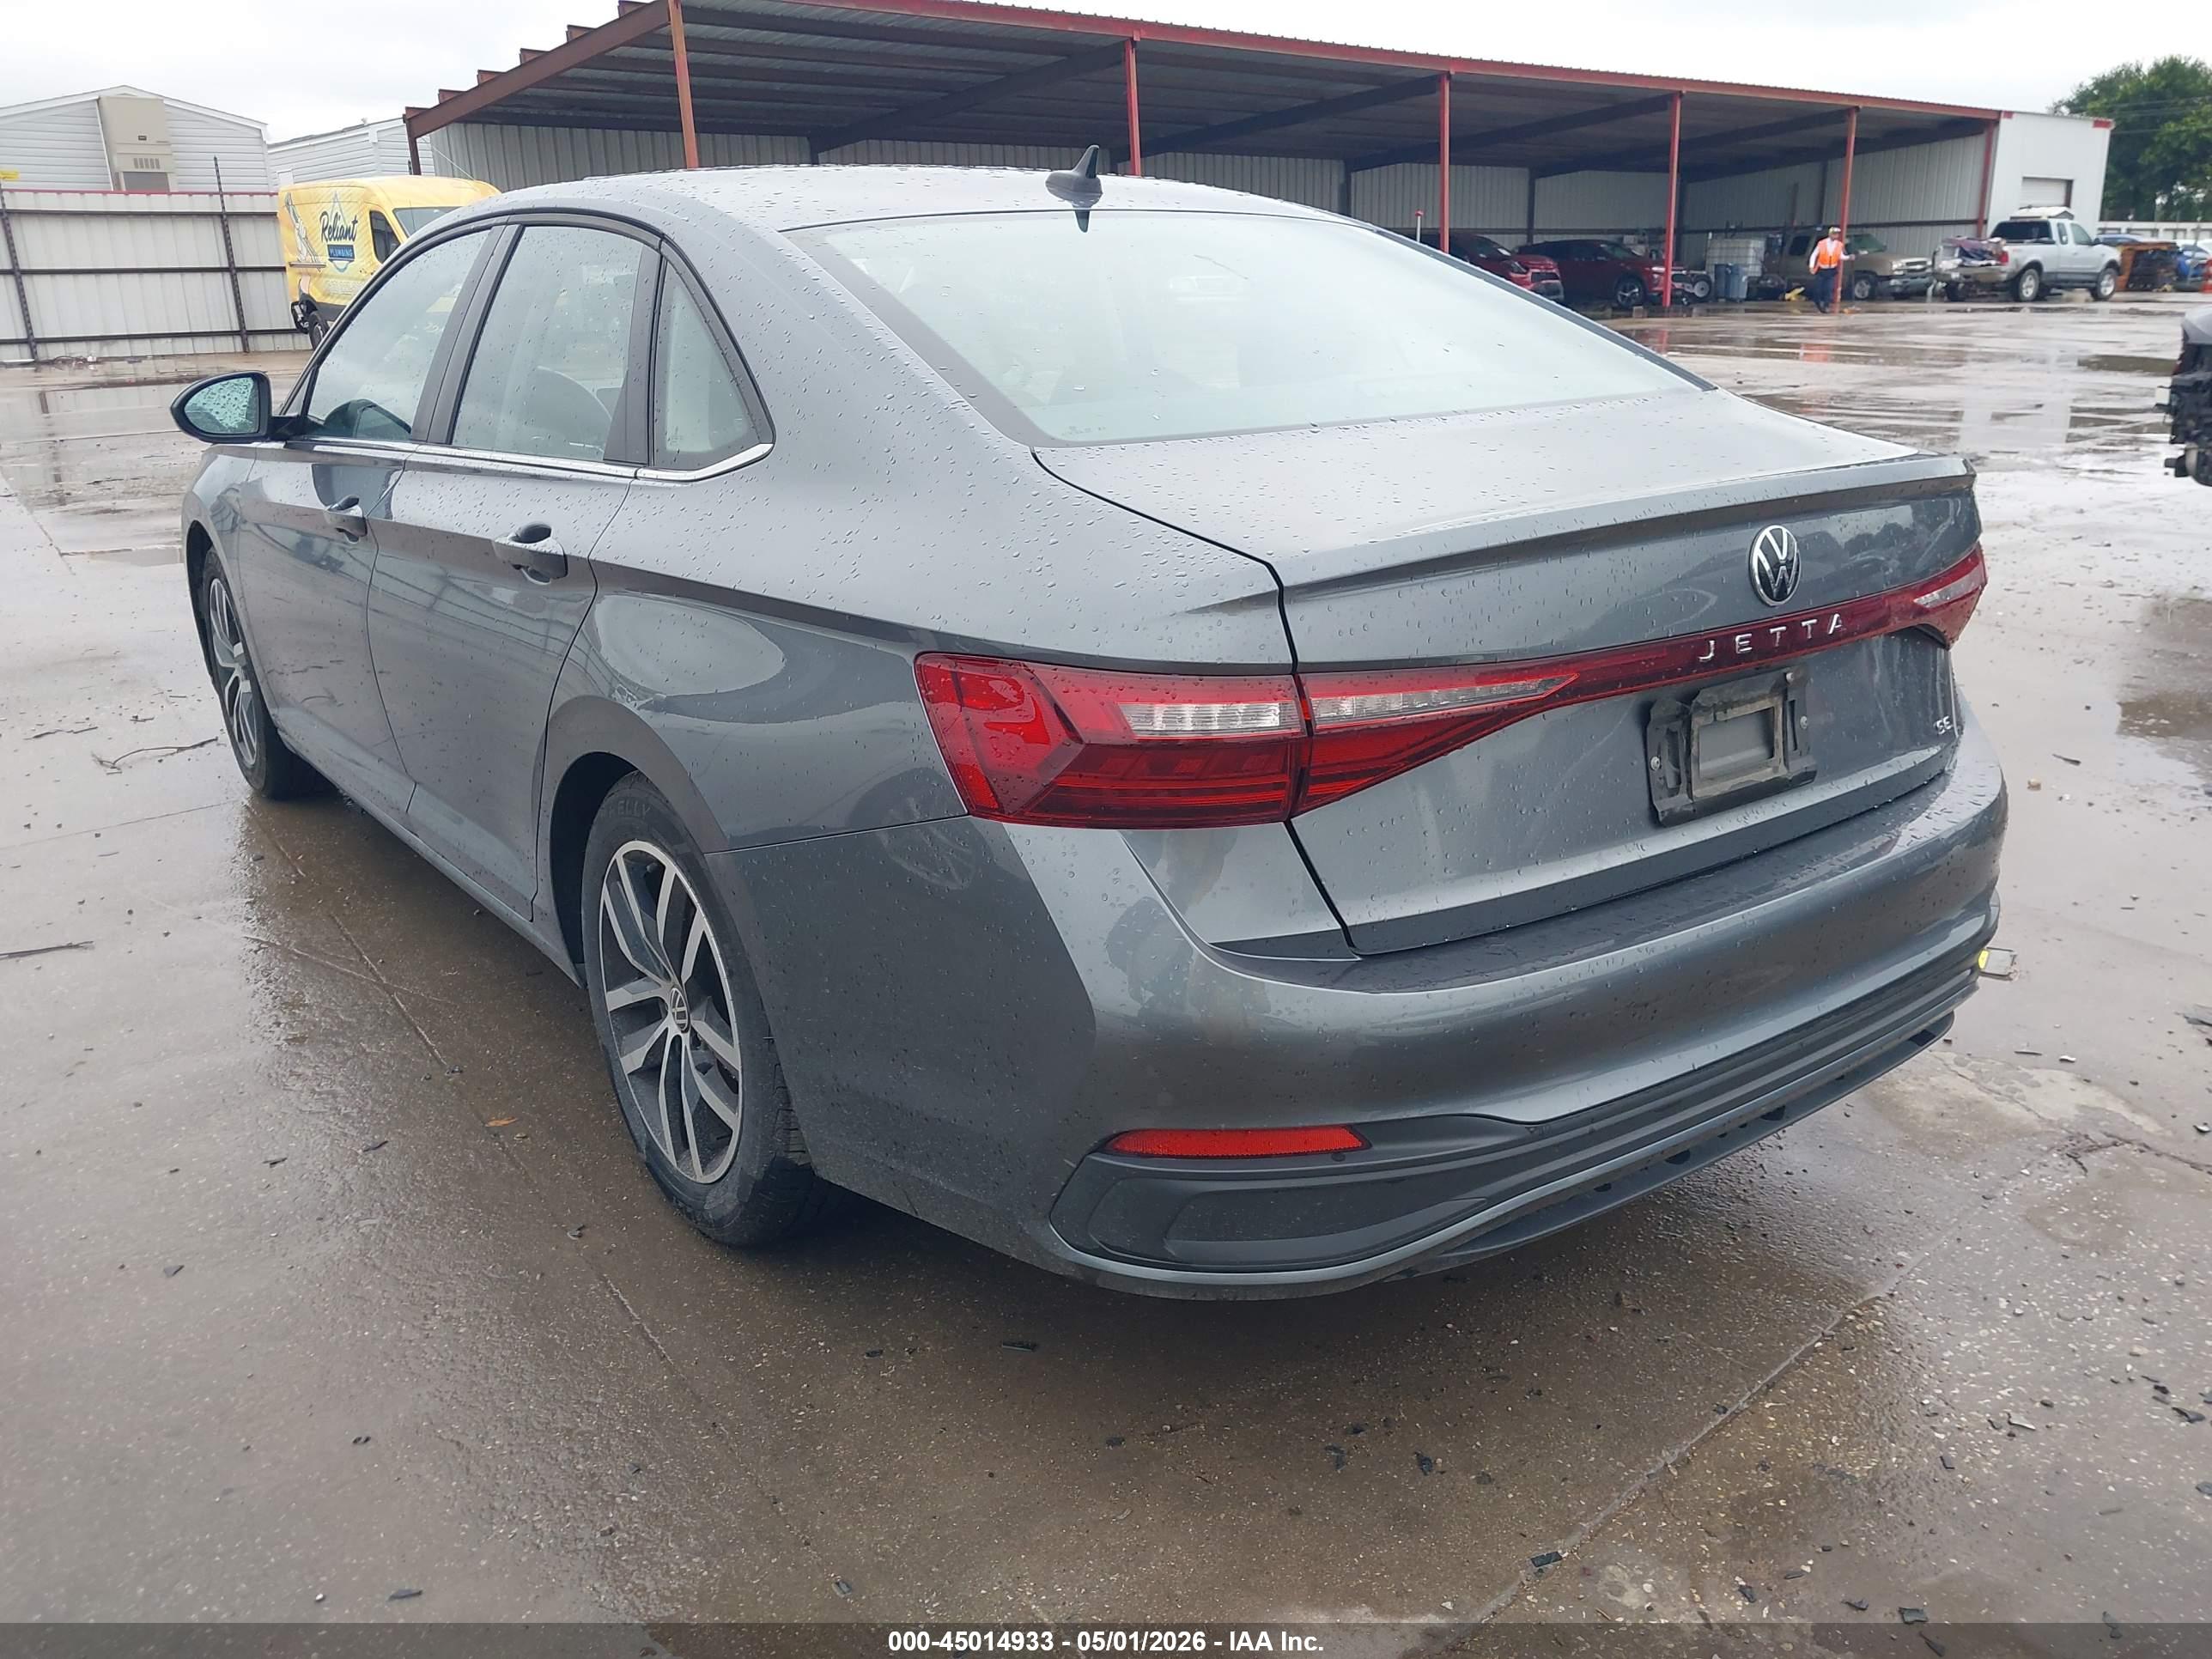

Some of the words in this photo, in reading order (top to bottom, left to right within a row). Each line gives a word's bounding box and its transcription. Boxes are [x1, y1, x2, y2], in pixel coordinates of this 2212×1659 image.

[319, 210, 358, 242] Reliant
[329, 246, 353, 258] PLUMBING
[1698, 613, 1844, 663] JETTA
[1935, 715, 1953, 735] SE
